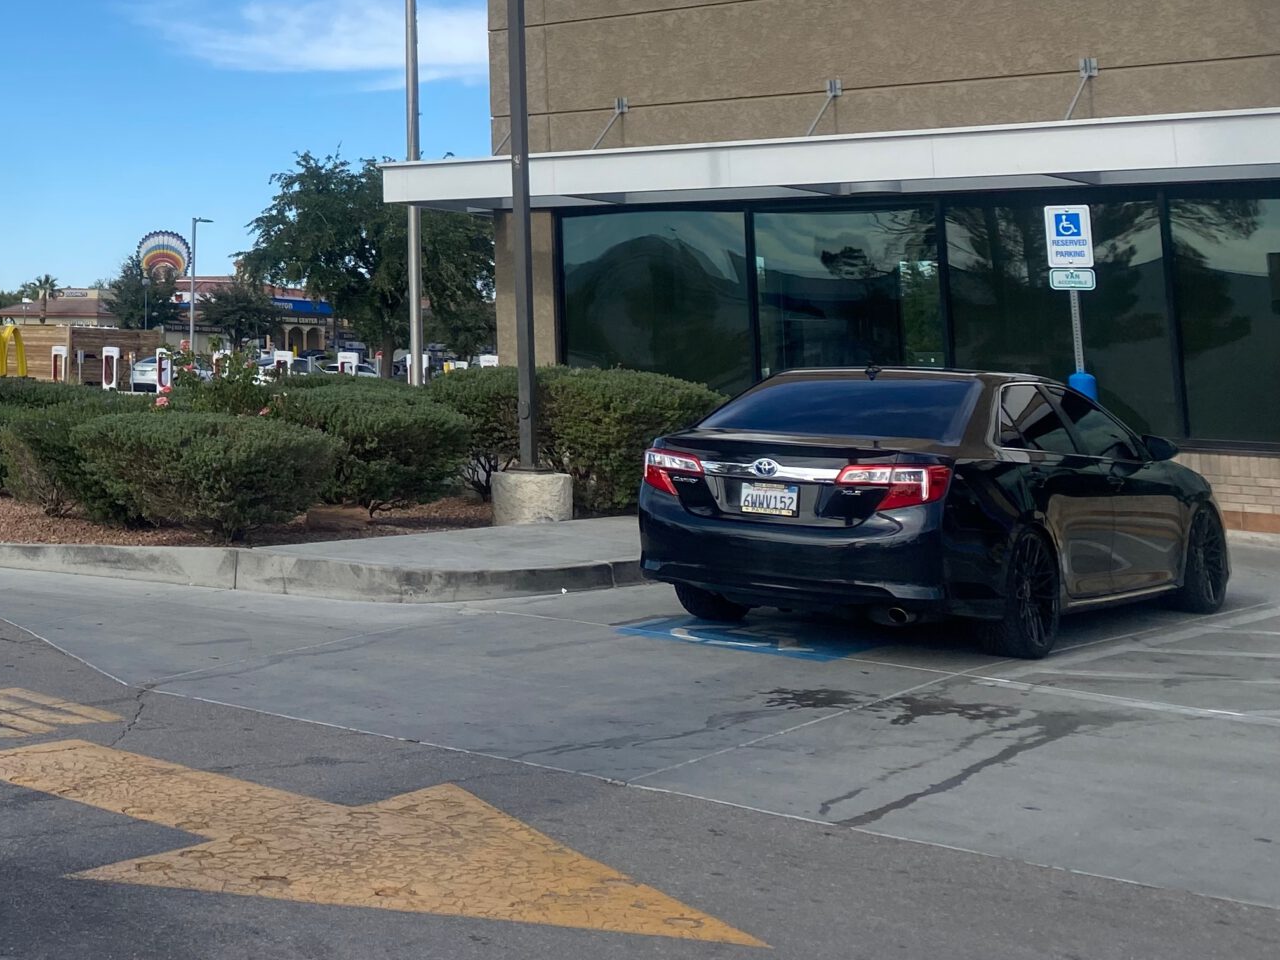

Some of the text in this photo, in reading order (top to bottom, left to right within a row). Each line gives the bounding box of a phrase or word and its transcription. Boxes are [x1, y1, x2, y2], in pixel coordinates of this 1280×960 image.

[1051, 239, 1088, 247] RESERVED
[1055, 250, 1086, 258] PARKING
[743, 493, 795, 511] 6WWV152
